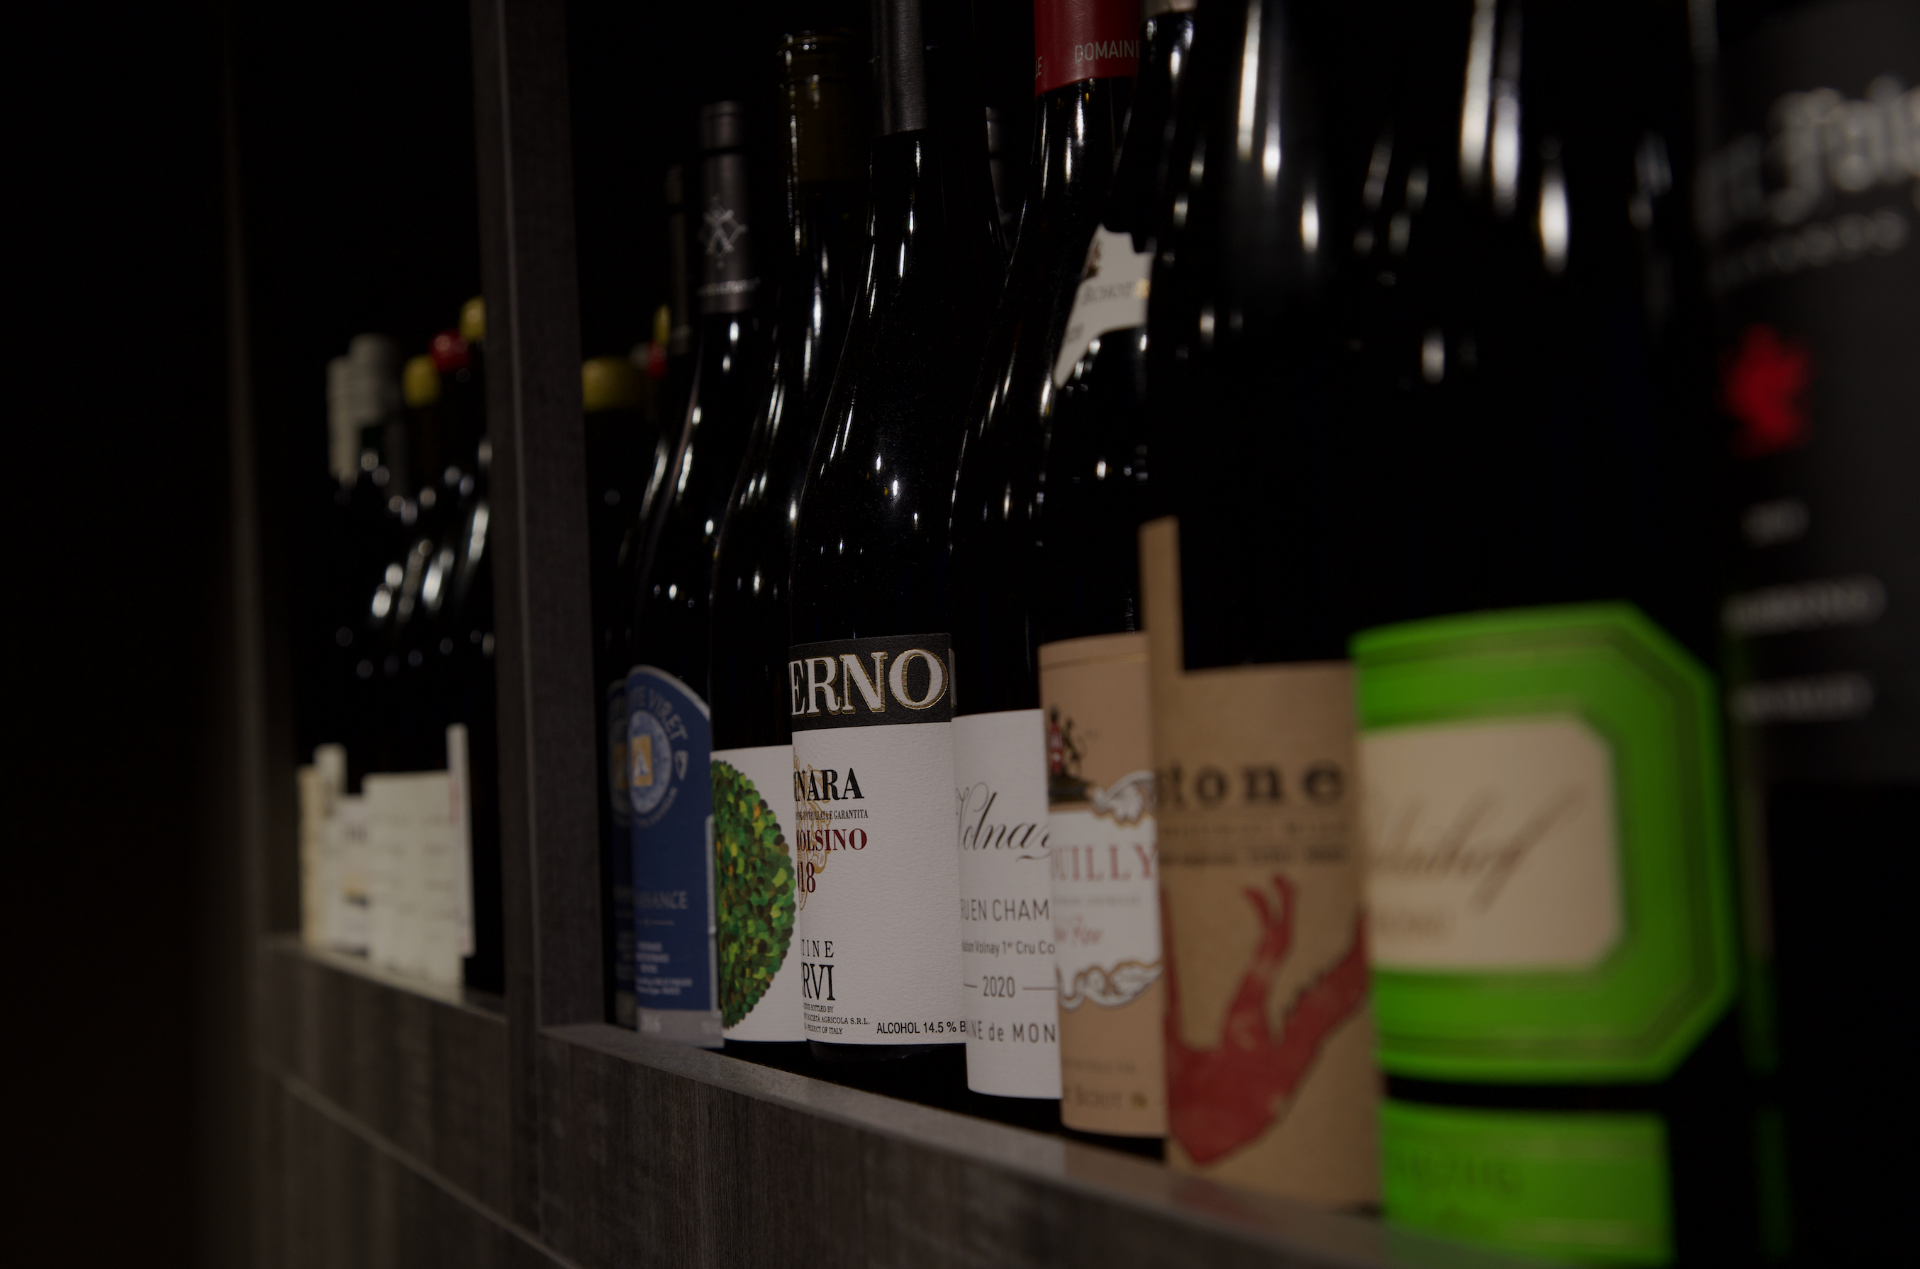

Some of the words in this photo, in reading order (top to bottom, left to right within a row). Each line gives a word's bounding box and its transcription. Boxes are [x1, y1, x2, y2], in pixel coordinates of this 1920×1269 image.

[834, 808, 869, 819] GARANTITA
[992, 898, 1050, 922] CHAM
[975, 940, 1001, 958] Volnay
[1016, 940, 1036, 955] Cru
[1038, 940, 1056, 955] Co
[982, 975, 1016, 999] 2020
[821, 1016, 849, 1025] AGRICOLA
[850, 1017, 871, 1025] S.R.L.
[876, 1022, 920, 1034] ALCOHOL
[923, 1021, 944, 1034] 14.5
[946, 1020, 957, 1033] %
[829, 1027, 844, 1035] ITALY
[988, 1022, 1005, 1043] de
[1012, 1023, 1057, 1044] MON
